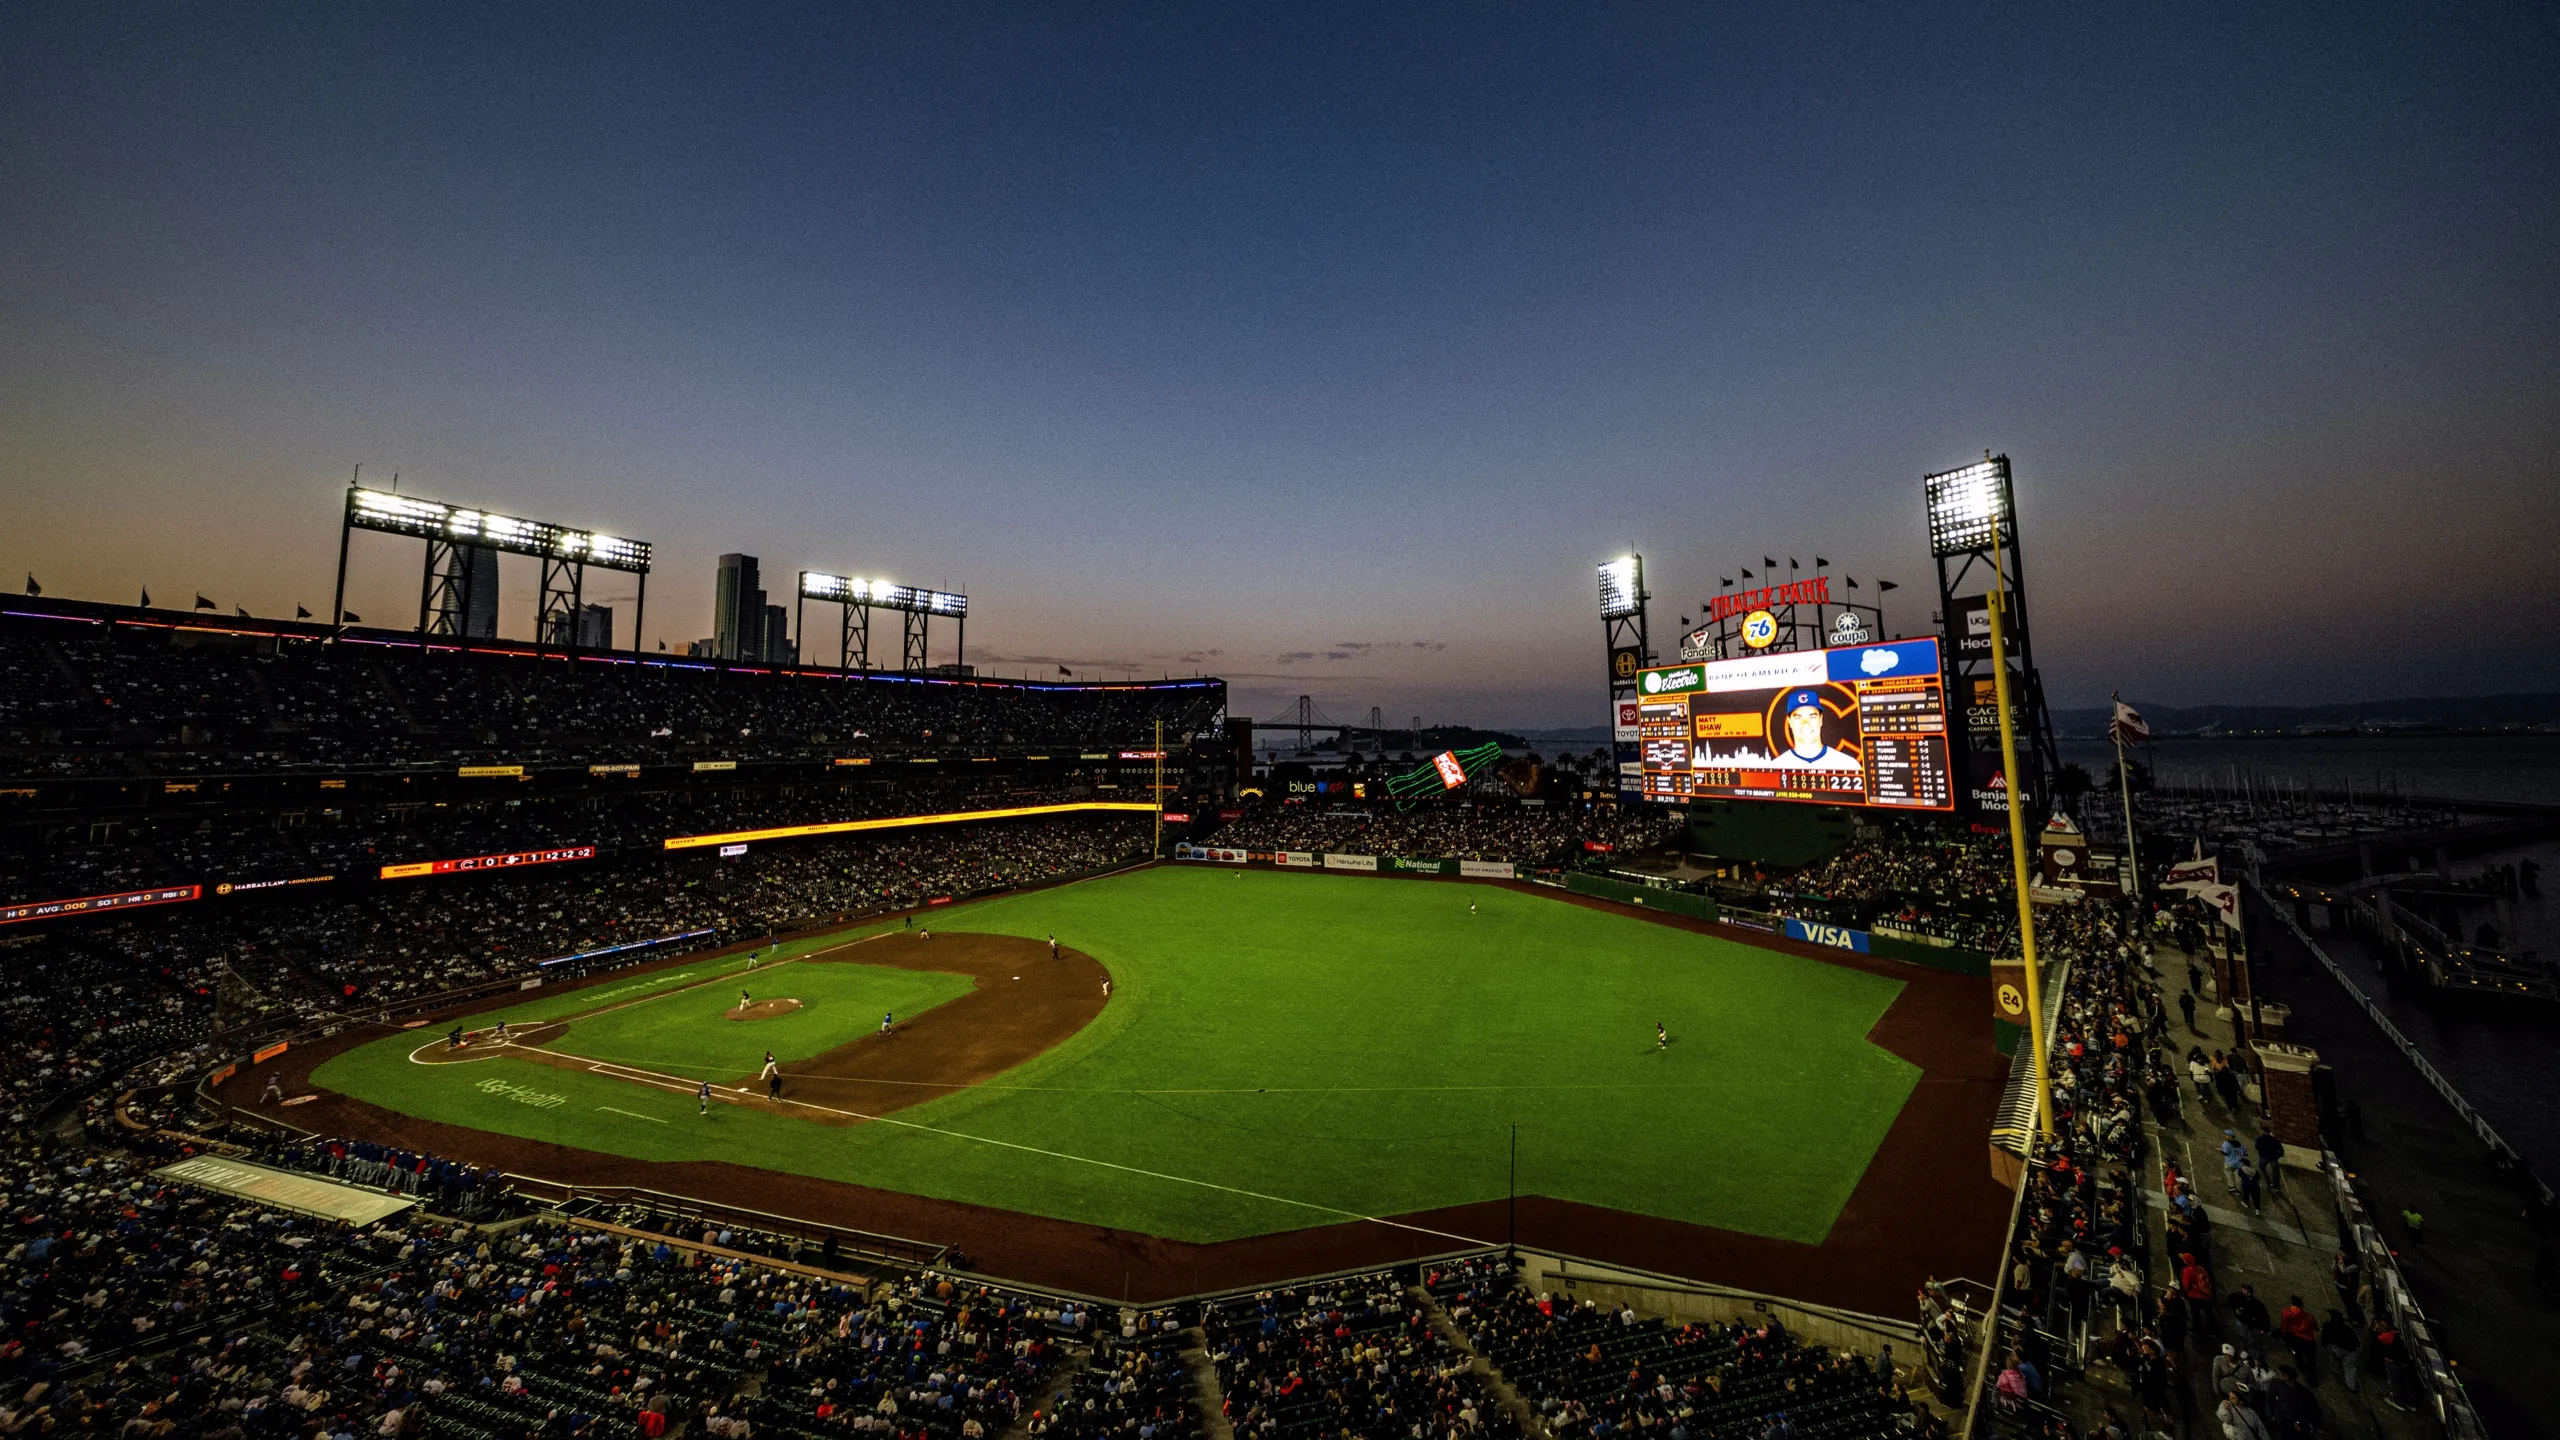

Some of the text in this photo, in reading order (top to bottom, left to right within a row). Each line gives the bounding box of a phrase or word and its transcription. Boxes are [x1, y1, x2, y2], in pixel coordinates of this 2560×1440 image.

[1710, 576, 1831, 622] ORACLE PARK
[1970, 616, 1990, 626] UCS
[1748, 619, 1770, 638] 76
[1832, 632, 1868, 644] coupa
[1960, 636, 2009, 650] Hea
[1662, 673, 1699, 692] Electric
[1966, 706, 2018, 716] CACE
[1698, 716, 1716, 724] MATT
[1968, 716, 2017, 726] CRE
[1699, 724, 1722, 732] SHAW
[1289, 780, 1315, 792] blue
[1830, 776, 1863, 790] 2 2 2
[1972, 789, 2030, 802] Benjain
[1982, 800, 2024, 811] Moo
[486, 858, 494, 866] 0
[531, 854, 536, 862] 1
[1405, 860, 1440, 869] National
[234, 881, 266, 890] HABBAS
[36, 906, 58, 914] AVG
[61, 902, 86, 911] .000
[128, 895, 140, 903] HR
[1799, 921, 1853, 950] VISA
[1878, 919, 1960, 940] WELCOME TO THE
[2002, 991, 2020, 1008] 24
